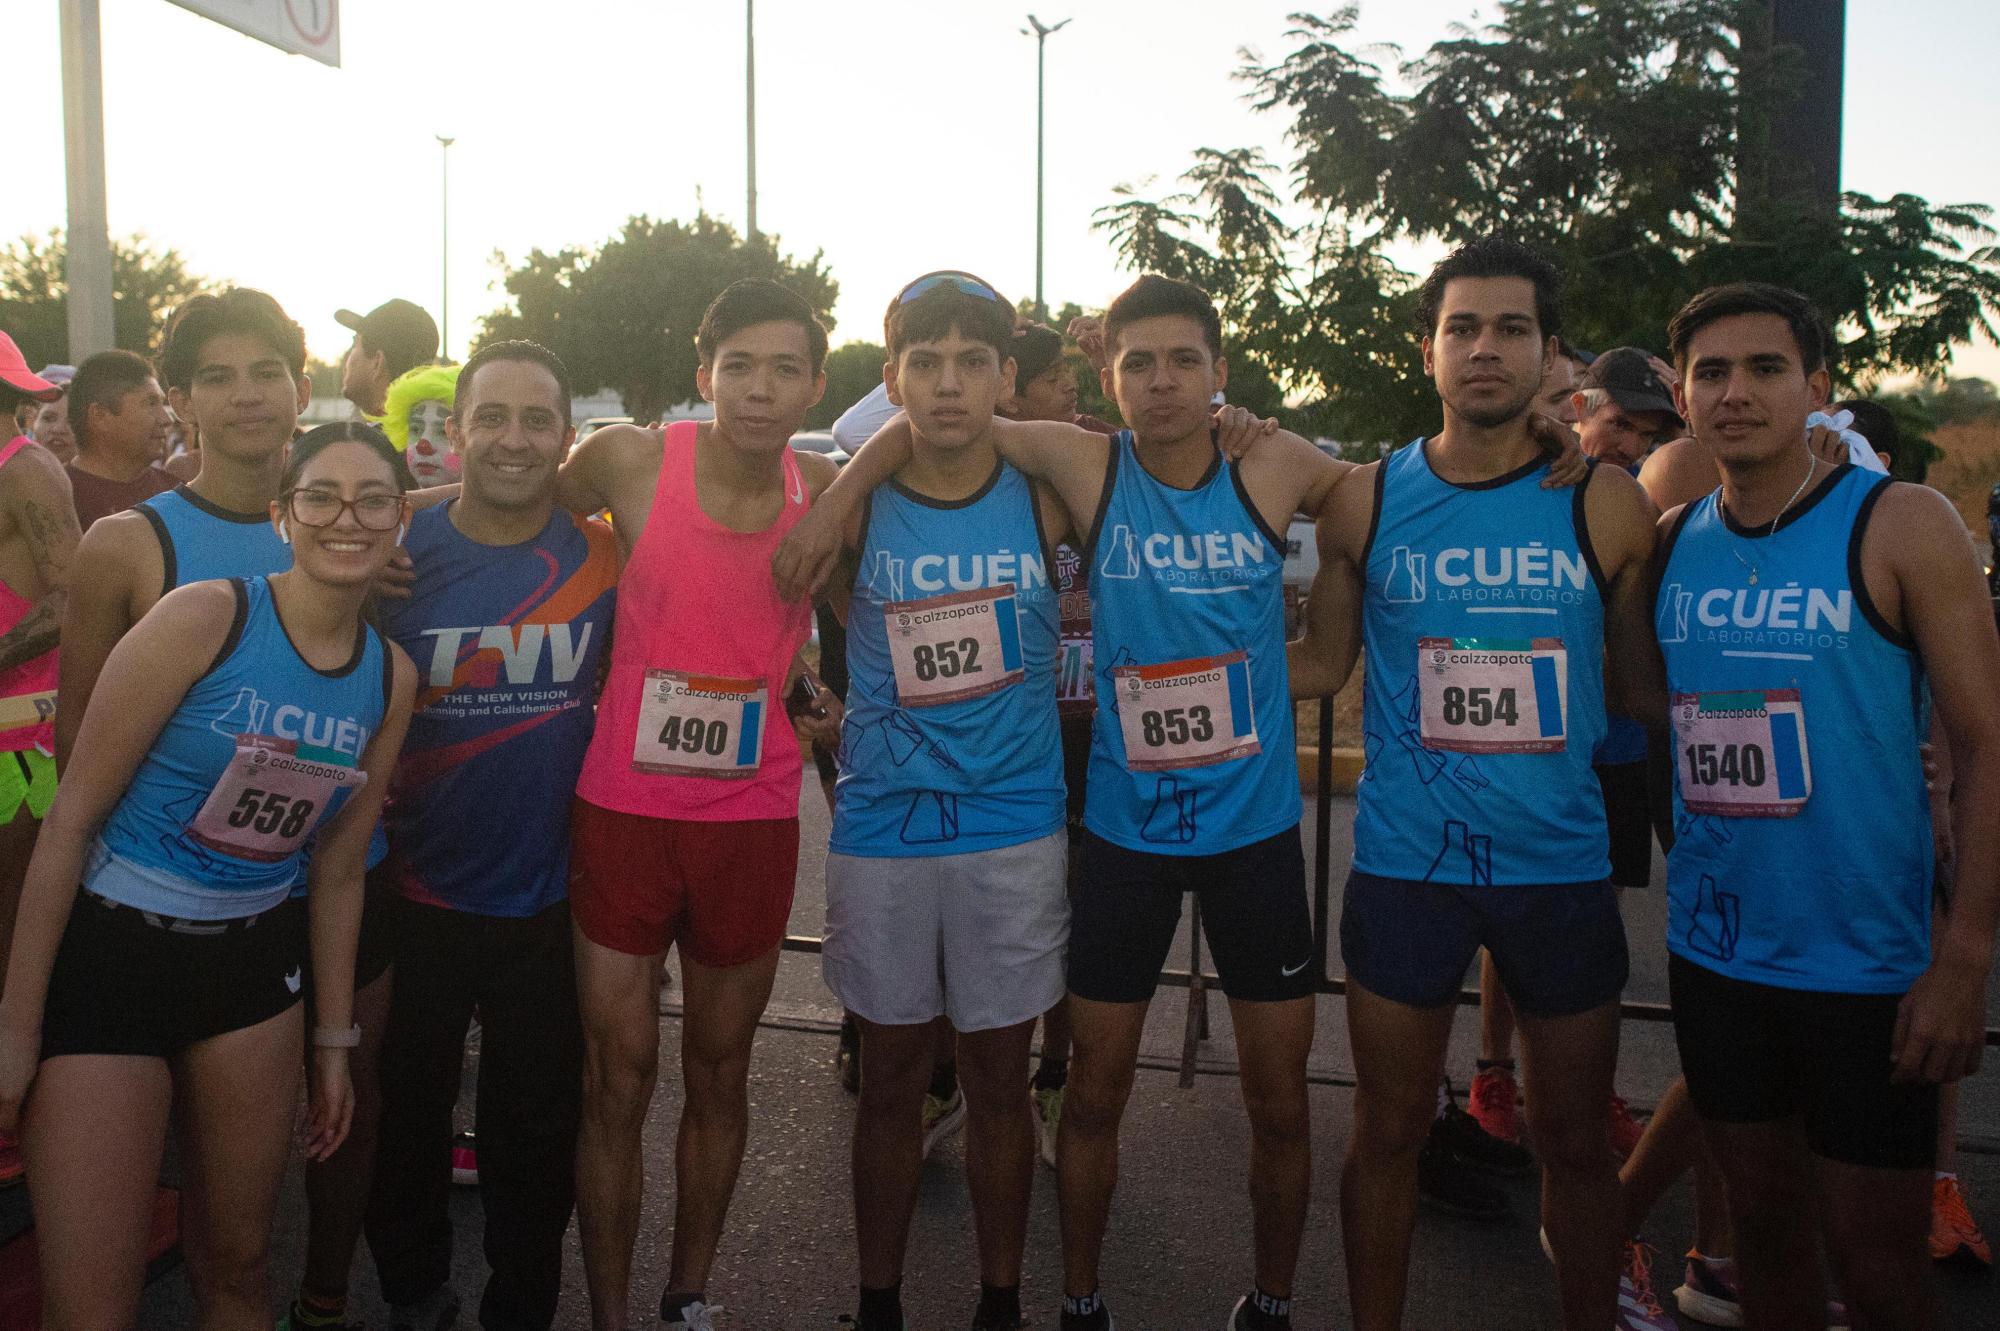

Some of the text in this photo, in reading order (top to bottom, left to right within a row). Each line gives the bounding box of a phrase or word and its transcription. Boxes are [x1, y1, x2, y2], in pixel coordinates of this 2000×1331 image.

[1145, 530, 1266, 569] CUÉN
[1434, 542, 1588, 591] CUÉN
[911, 549, 1046, 592] CUÉN
[1154, 567, 1268, 583] ABORATORIOS
[914, 603, 989, 626] calzzapato
[1697, 582, 1852, 632] CUÉN
[913, 637, 984, 682] 852
[1450, 653, 1533, 666] calzzapato
[1697, 630, 1849, 650] LABORATORIOS
[442, 689, 568, 704] THE NEW VISION
[1144, 671, 1221, 691] calzzapato
[423, 698, 581, 718] Running and Calisthenics Club
[1141, 705, 1214, 747] 853
[1443, 686, 1519, 727] 854
[658, 716, 728, 756] 490
[270, 756, 346, 781] calzzapato
[1685, 743, 1766, 787] 1540
[228, 788, 314, 838] 558
